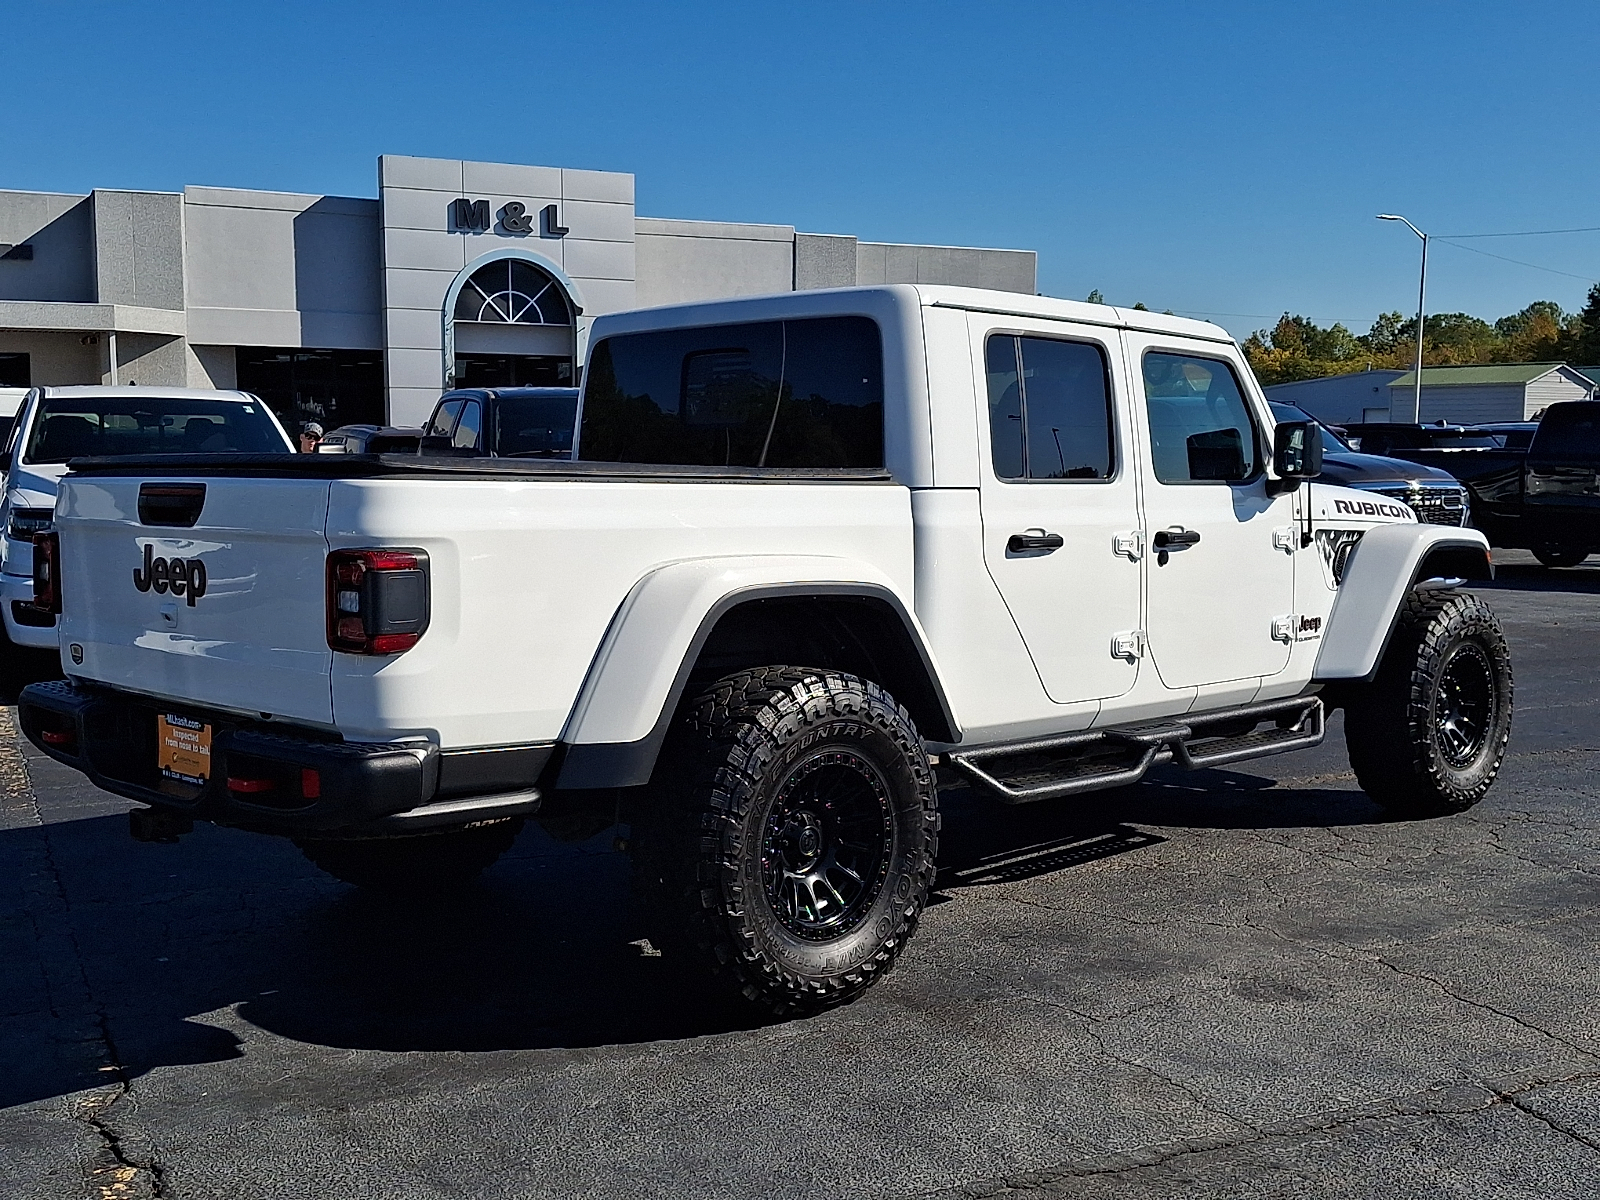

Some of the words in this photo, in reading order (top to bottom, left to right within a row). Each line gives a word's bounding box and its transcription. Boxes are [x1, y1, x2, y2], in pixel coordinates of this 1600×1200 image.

[454, 198, 491, 230] M
[503, 201, 534, 233] &
[548, 204, 570, 234] L
[1334, 499, 1412, 520] RUBICON
[133, 543, 207, 608] Jeep
[1298, 614, 1322, 633] Jeep
[165, 737, 178, 748] from
[179, 742, 192, 751] nose
[193, 744, 199, 752] to
[173, 729, 199, 742] Inspected
[771, 722, 875, 783] COUNTRY
[875, 850, 917, 940] TOYO
[820, 942, 865, 975] M/T
